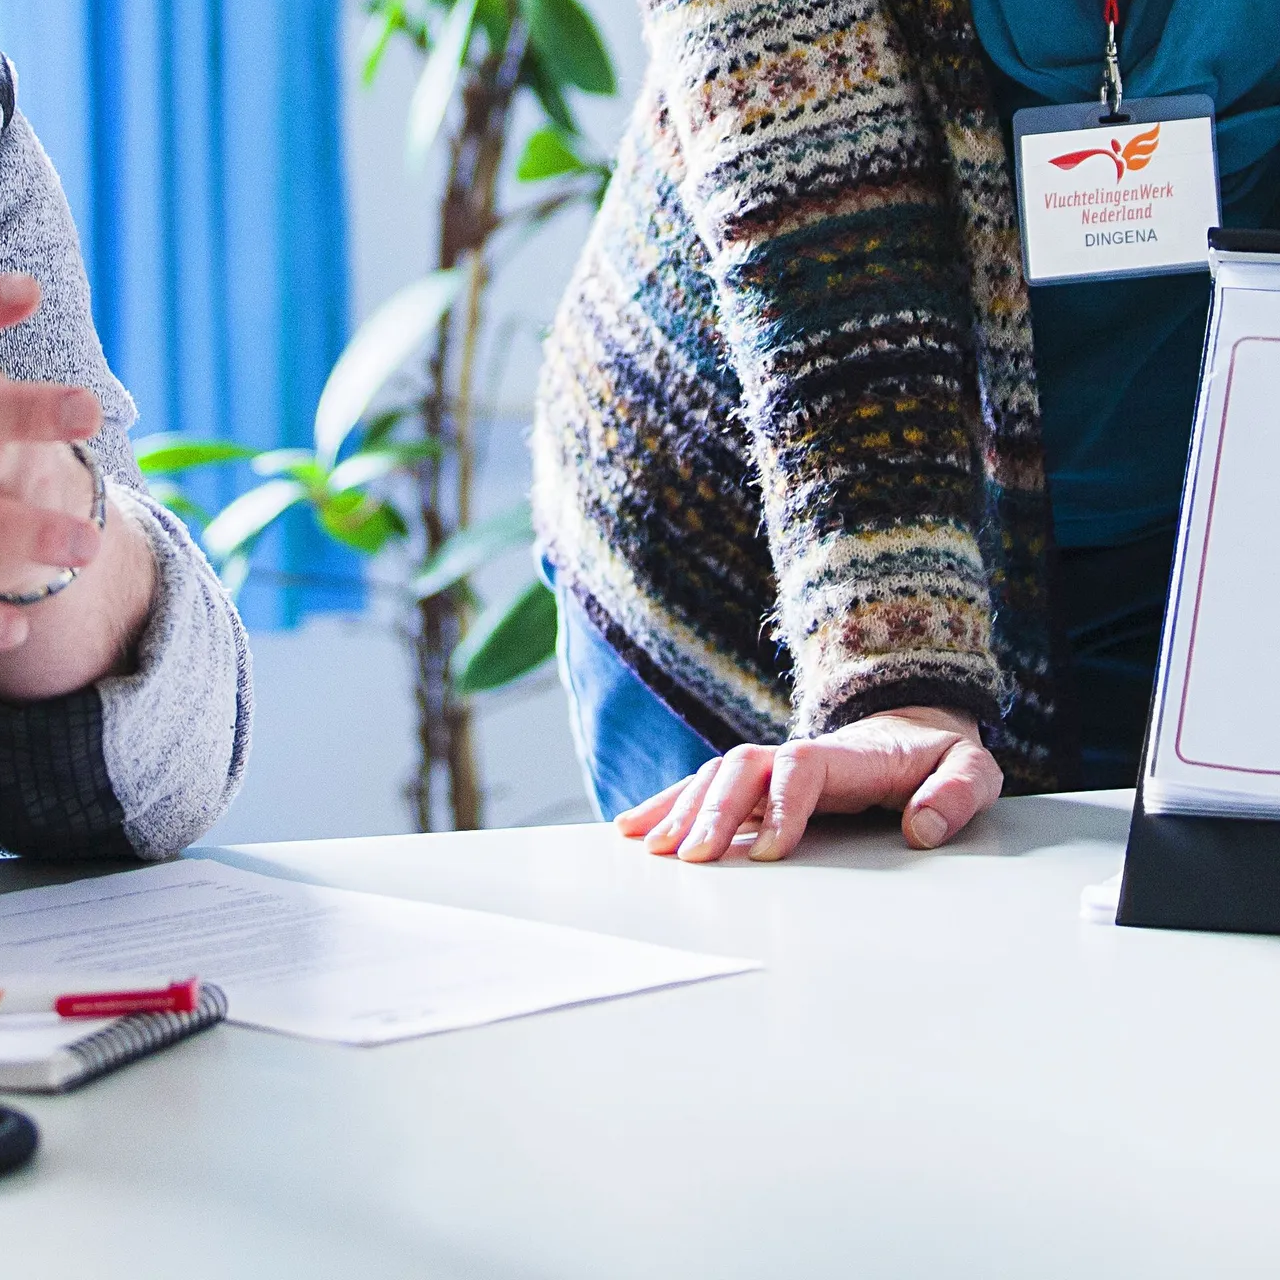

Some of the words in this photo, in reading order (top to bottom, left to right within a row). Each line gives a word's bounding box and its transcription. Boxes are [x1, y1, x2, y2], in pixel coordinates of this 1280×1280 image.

[1044, 181, 1174, 209] VluchtelingenWerk
[1081, 203, 1153, 225] Nederland
[1084, 228, 1158, 247] DINGENA
